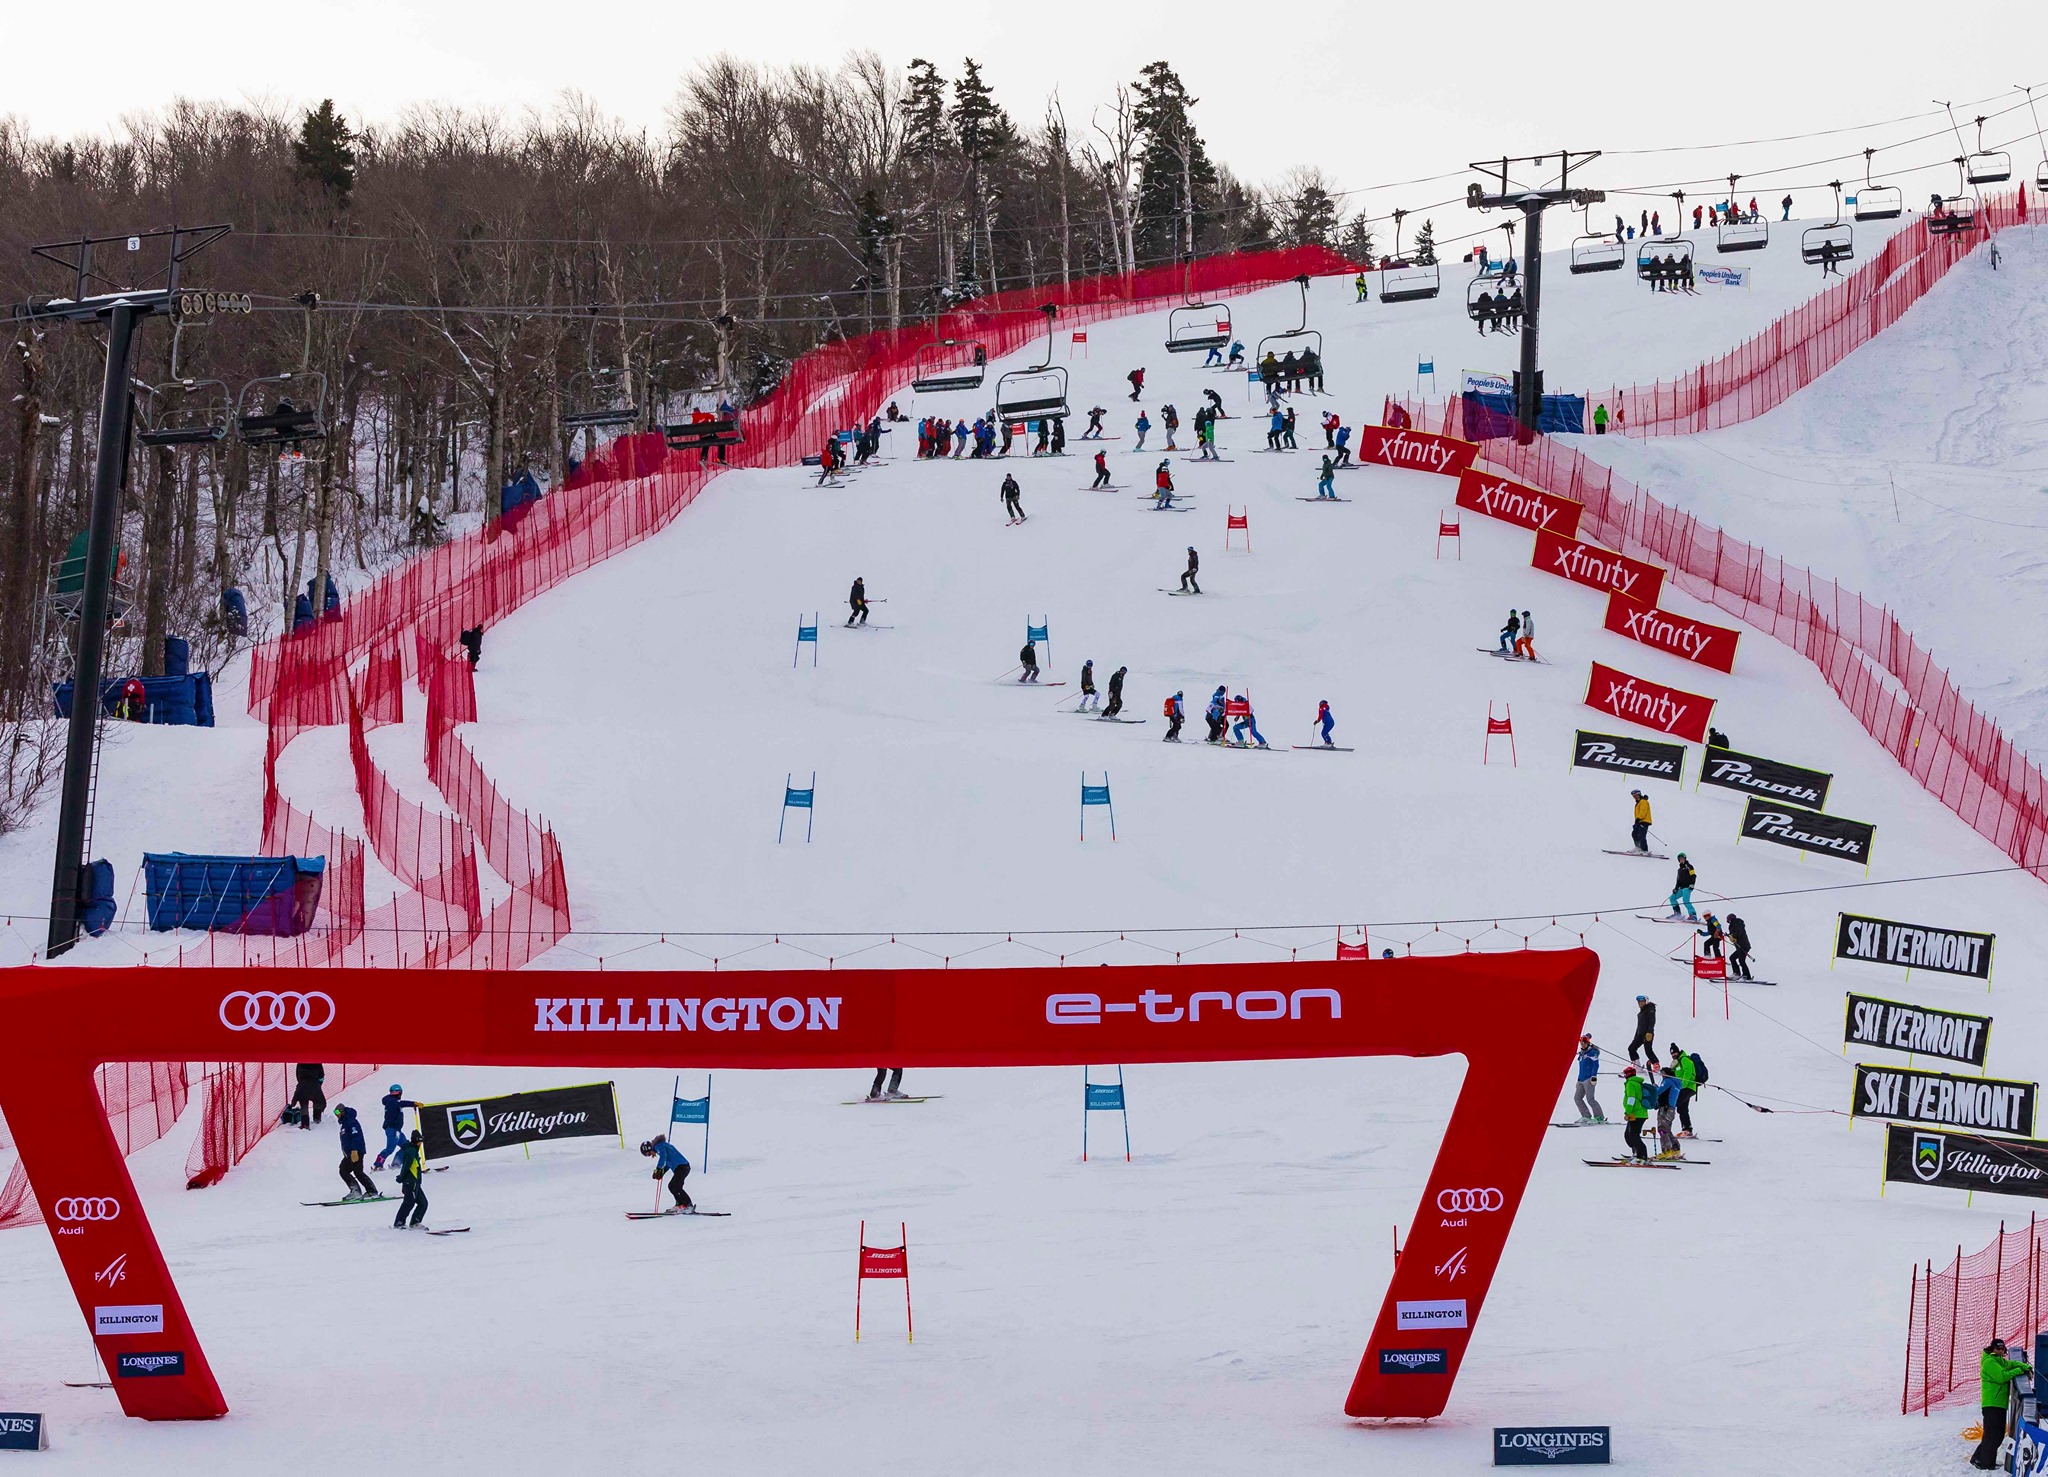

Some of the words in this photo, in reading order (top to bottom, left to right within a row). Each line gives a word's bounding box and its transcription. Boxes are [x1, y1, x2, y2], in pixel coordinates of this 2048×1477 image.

[1699, 270, 1720, 279] People's
[1721, 271, 1742, 280] United
[1467, 377, 1495, 388] People's
[1495, 382, 1513, 391] Unite
[1378, 432, 1456, 472] xfinity
[1476, 482, 1558, 528] xfinity
[1554, 544, 1640, 593] xfinity
[1624, 608, 1712, 660] xfinity
[1605, 679, 1688, 732] xfinity
[1582, 742, 1674, 774] Prinoth
[1711, 760, 1818, 802] Prinoth
[1752, 812, 1861, 854] Prinoth
[1846, 921, 1882, 959] SKI
[1885, 925, 1985, 974] VERMONT
[534, 997, 842, 1032] KILLINGTON
[1046, 988, 1342, 1024] e-tron
[1852, 1001, 1883, 1041] SKI
[1886, 1008, 1983, 1060] VERMONT
[1864, 1072, 1903, 1114] SKI
[1908, 1076, 2025, 1130] VERMONT
[488, 1110, 590, 1138] Killington
[1946, 1150, 2043, 1185] Killington
[58, 1226, 85, 1236] Audi
[1440, 1218, 1468, 1228] Audi
[99, 1315, 159, 1325] KILLINGTON
[1402, 1310, 1462, 1320] KILLINGTON
[122, 1356, 178, 1368] LONGINES
[1384, 1353, 1440, 1364] LONGINES
[1500, 1432, 1604, 1449] LONGINES
